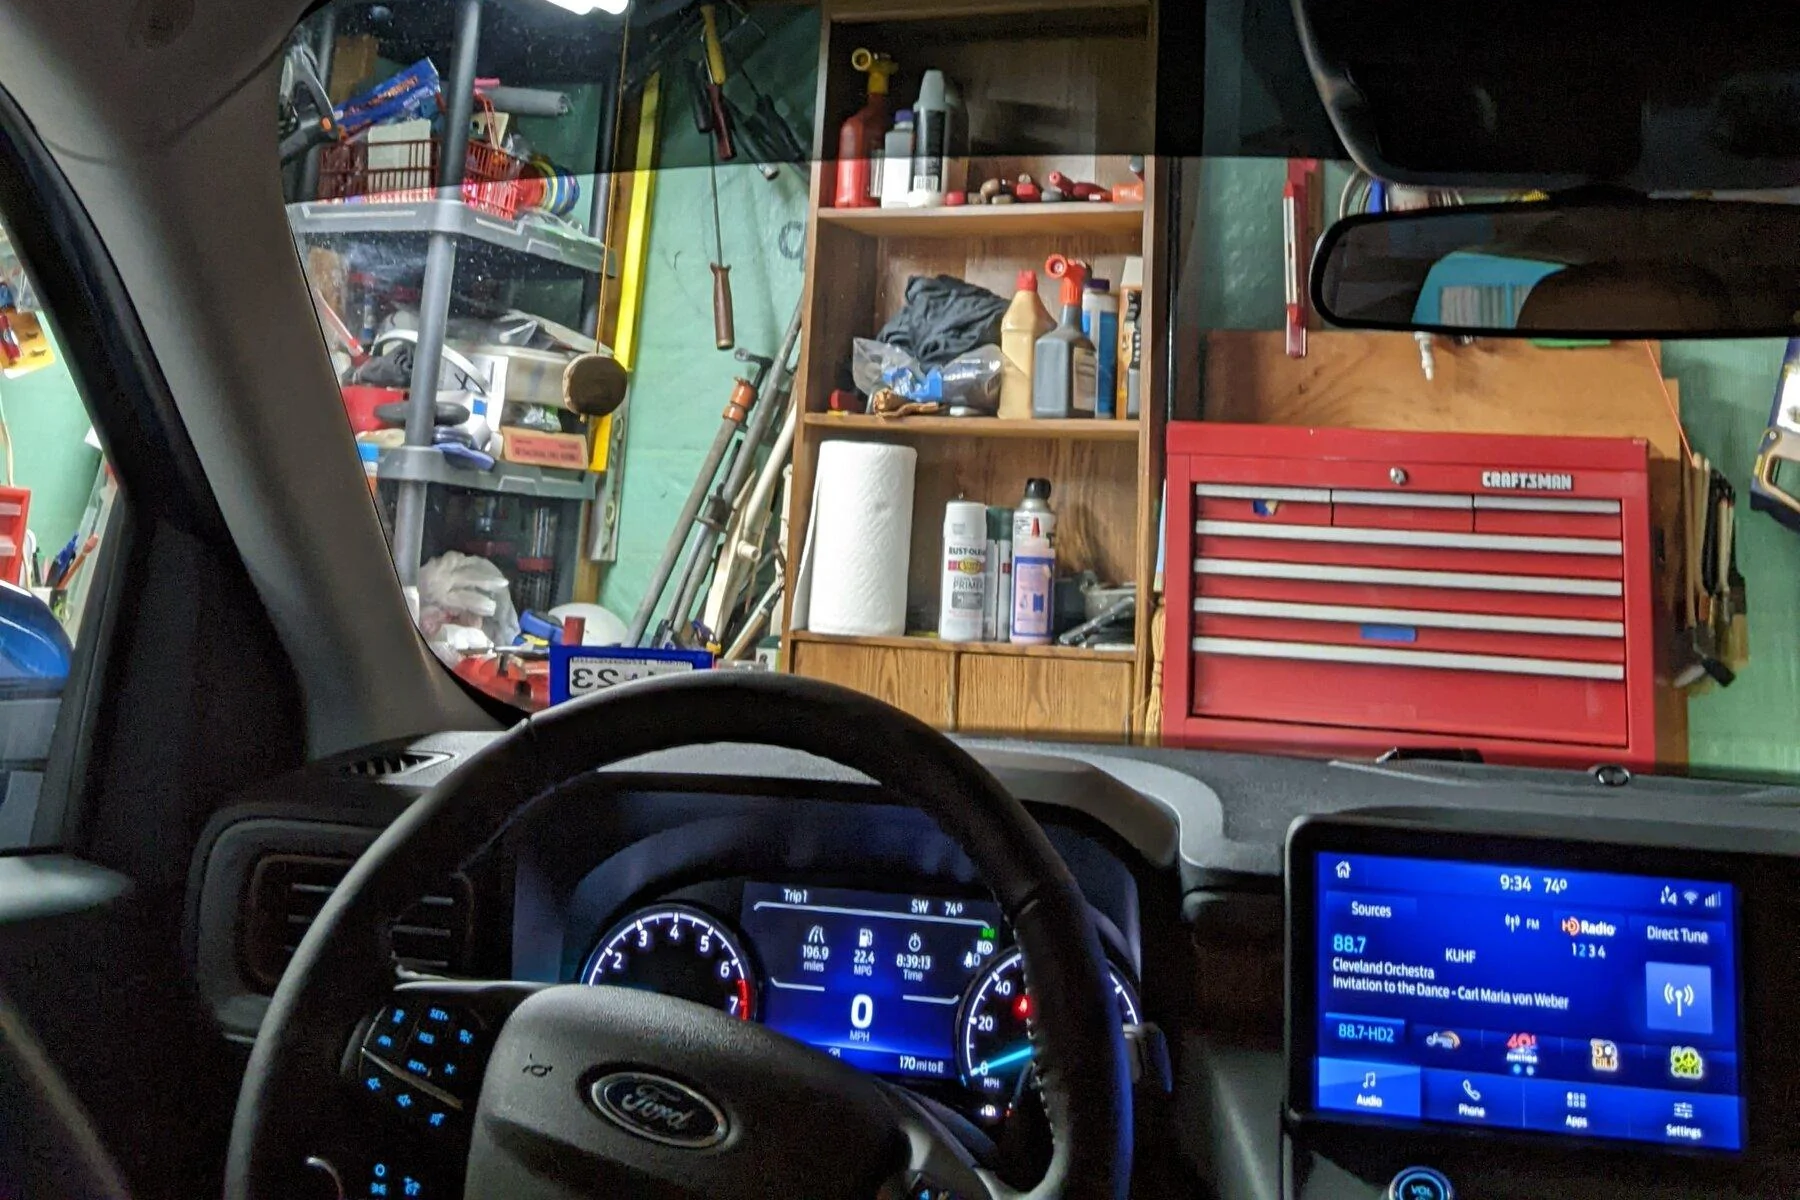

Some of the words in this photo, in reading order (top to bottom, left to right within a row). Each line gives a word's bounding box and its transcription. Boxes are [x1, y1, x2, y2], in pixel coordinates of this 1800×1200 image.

[1481, 470, 1573, 490] CRAFTSMAN
[1500, 874, 1532, 893] 9:34
[784, 888, 801, 903] Trip
[911, 899, 929, 914] SW
[1351, 901, 1392, 918] Sources
[670, 924, 679, 940] 4
[1526, 918, 1540, 931] FM
[638, 930, 648, 947] 3
[1647, 925, 1678, 942] Direct
[1680, 927, 1709, 944] Tune
[700, 935, 709, 952] 5
[1333, 933, 1366, 954] 88.7
[802, 944, 829, 960] 196.9
[853, 950, 875, 965] 22.4
[1445, 947, 1476, 964] KUHF
[613, 952, 622, 969] 2
[804, 960, 824, 972] miles
[896, 954, 931, 970] 8:39:13
[1333, 956, 1383, 975] Cleveland
[1384, 962, 1435, 980] Orchestra
[720, 960, 730, 978] 6
[853, 965, 872, 976] MPG
[903, 970, 923, 982] Time
[995, 980, 1011, 996] 40
[1333, 974, 1382, 992] Invitation
[1384, 980, 1396, 993] to
[1397, 981, 1415, 995] the
[1417, 984, 1450, 998] Dance
[1457, 986, 1479, 1001] Carl
[1481, 989, 1510, 1004] Maria
[1511, 993, 1532, 1006] von
[1534, 992, 1570, 1010] Weber
[730, 996, 738, 1014] 7
[850, 993, 874, 1029] 0
[978, 1016, 993, 1031] 20
[849, 1031, 870, 1042] MPH
[1338, 1023, 1394, 1043] 88.7-HD2
[916, 1060, 927, 1071] mi
[928, 1061, 937, 1073] to
[983, 1077, 1000, 1089] MPH
[621, 1083, 696, 1129] Ford
[1356, 1094, 1383, 1108] Audio
[1458, 1103, 1485, 1118] Phone
[1565, 1115, 1588, 1129] Apps
[1666, 1124, 1702, 1140] Settings
